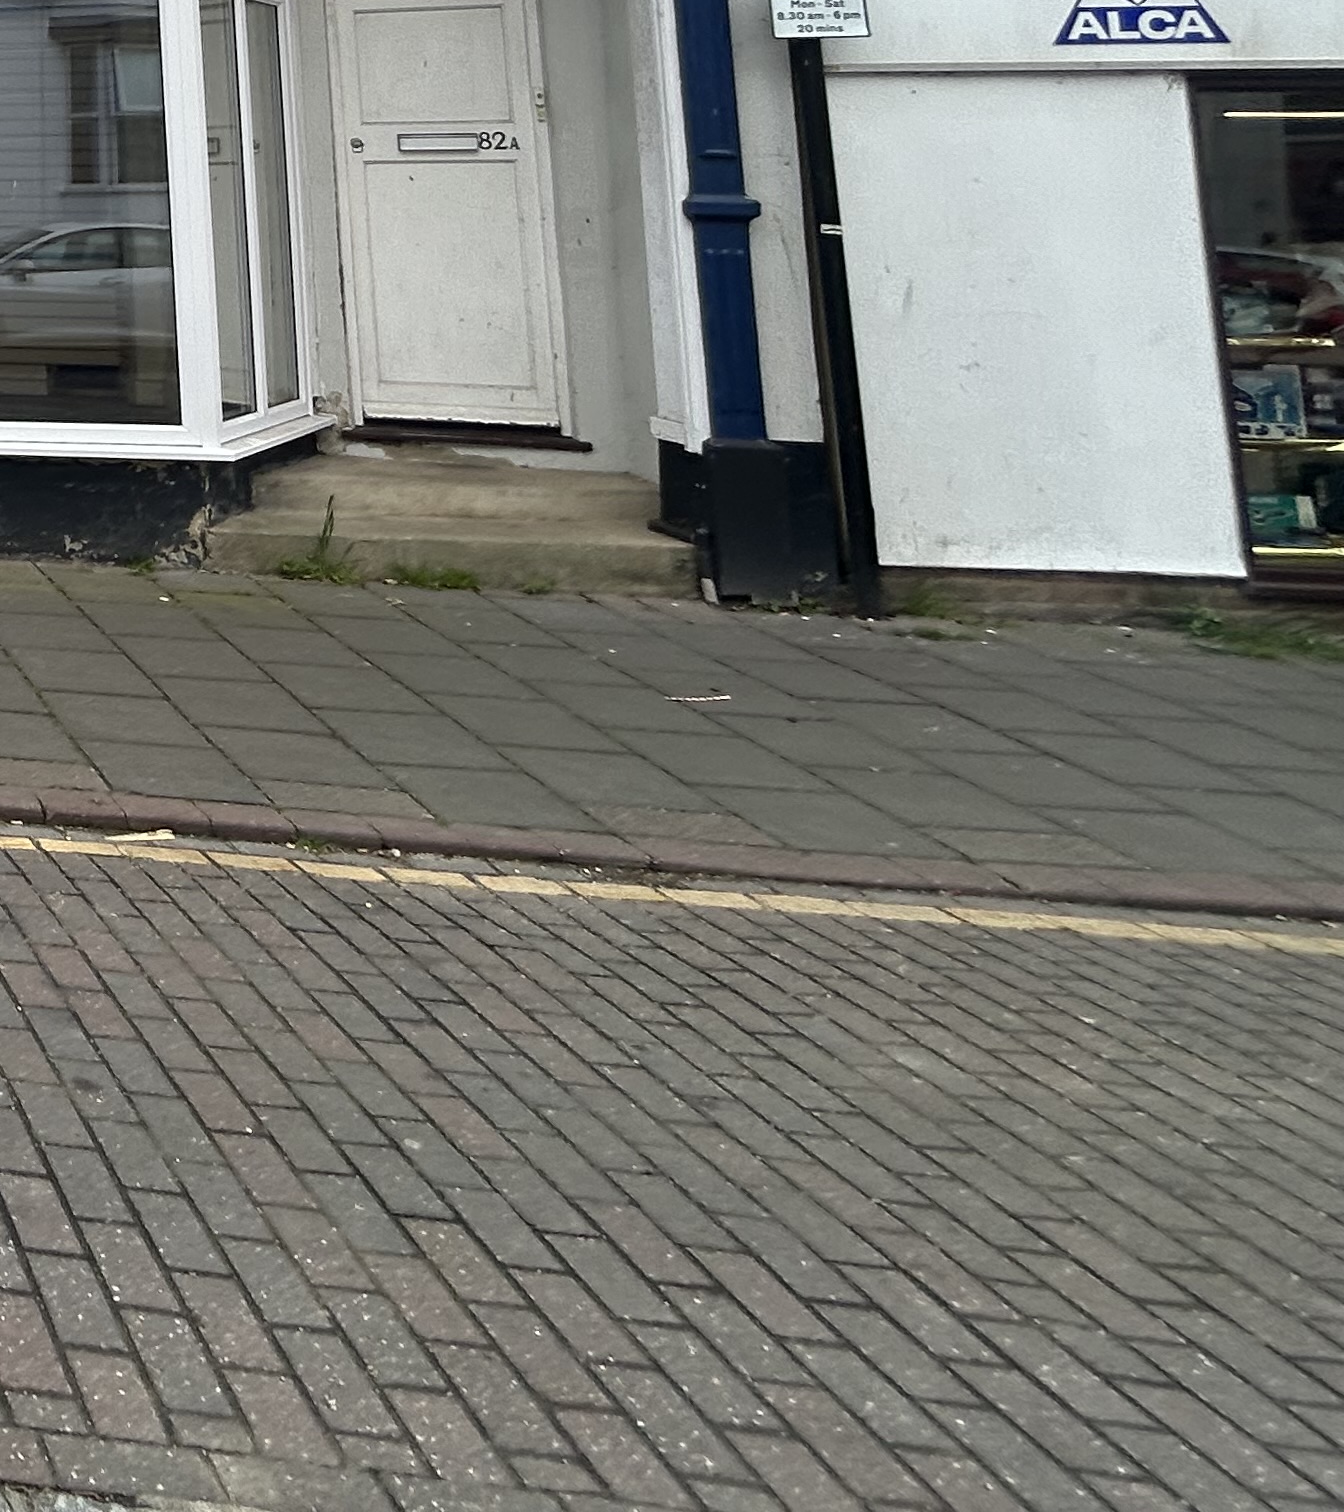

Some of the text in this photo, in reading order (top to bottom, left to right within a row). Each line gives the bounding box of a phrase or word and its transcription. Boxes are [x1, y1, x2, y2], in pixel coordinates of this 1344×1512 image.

[790, 0, 816, 9] Mon
[824, 0, 846, 9] Sat
[777, 11, 805, 21] 8.30
[833, 10, 841, 20] 6
[843, 11, 862, 21] pm
[797, 24, 844, 34] 20 mins
[1067, 9, 1216, 40] ALCA
[478, 131, 521, 151] 82A
